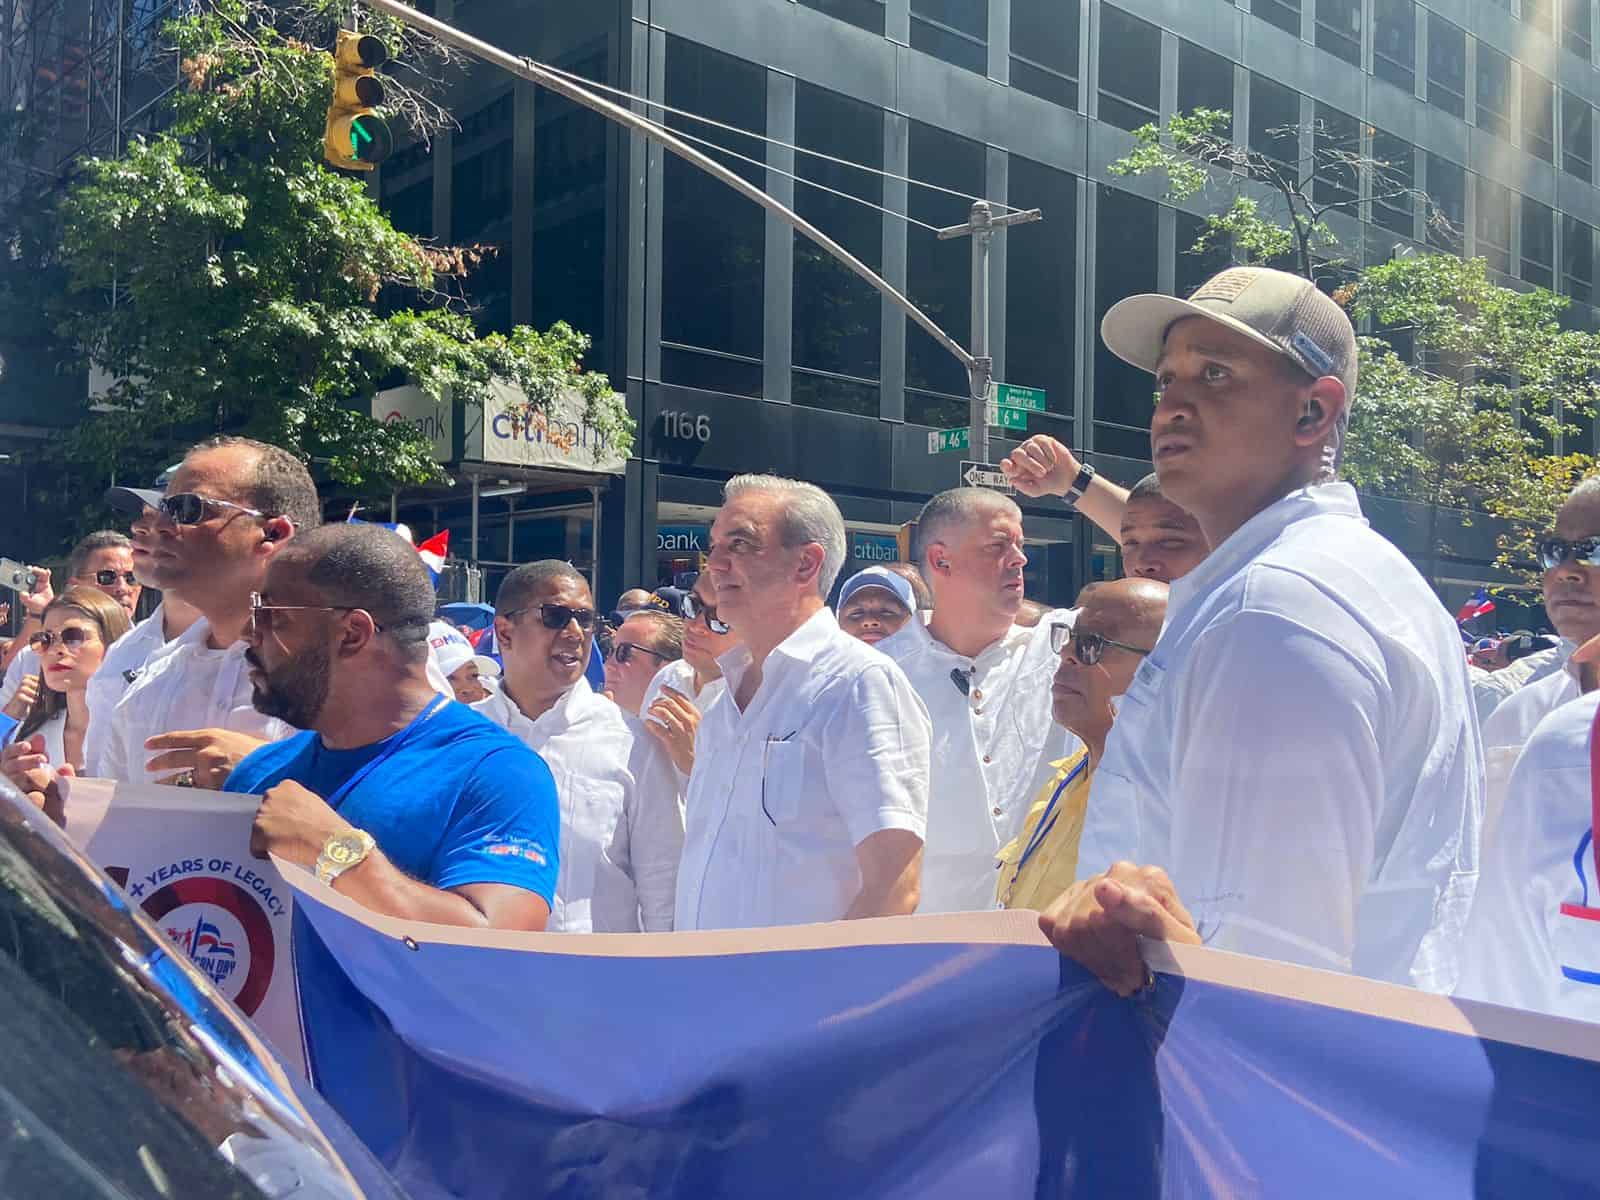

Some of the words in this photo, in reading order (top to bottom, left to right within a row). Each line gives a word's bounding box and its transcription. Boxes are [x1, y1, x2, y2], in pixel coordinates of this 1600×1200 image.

[660, 409, 711, 442] 1166
[1003, 410, 1010, 425] 6
[949, 432, 960, 449] 46
[969, 471, 985, 484] ONE
[992, 473, 1009, 486] WAY
[146, 858, 204, 886] YEARS
[208, 859, 233, 874] OF
[233, 865, 287, 917] LEGACY
